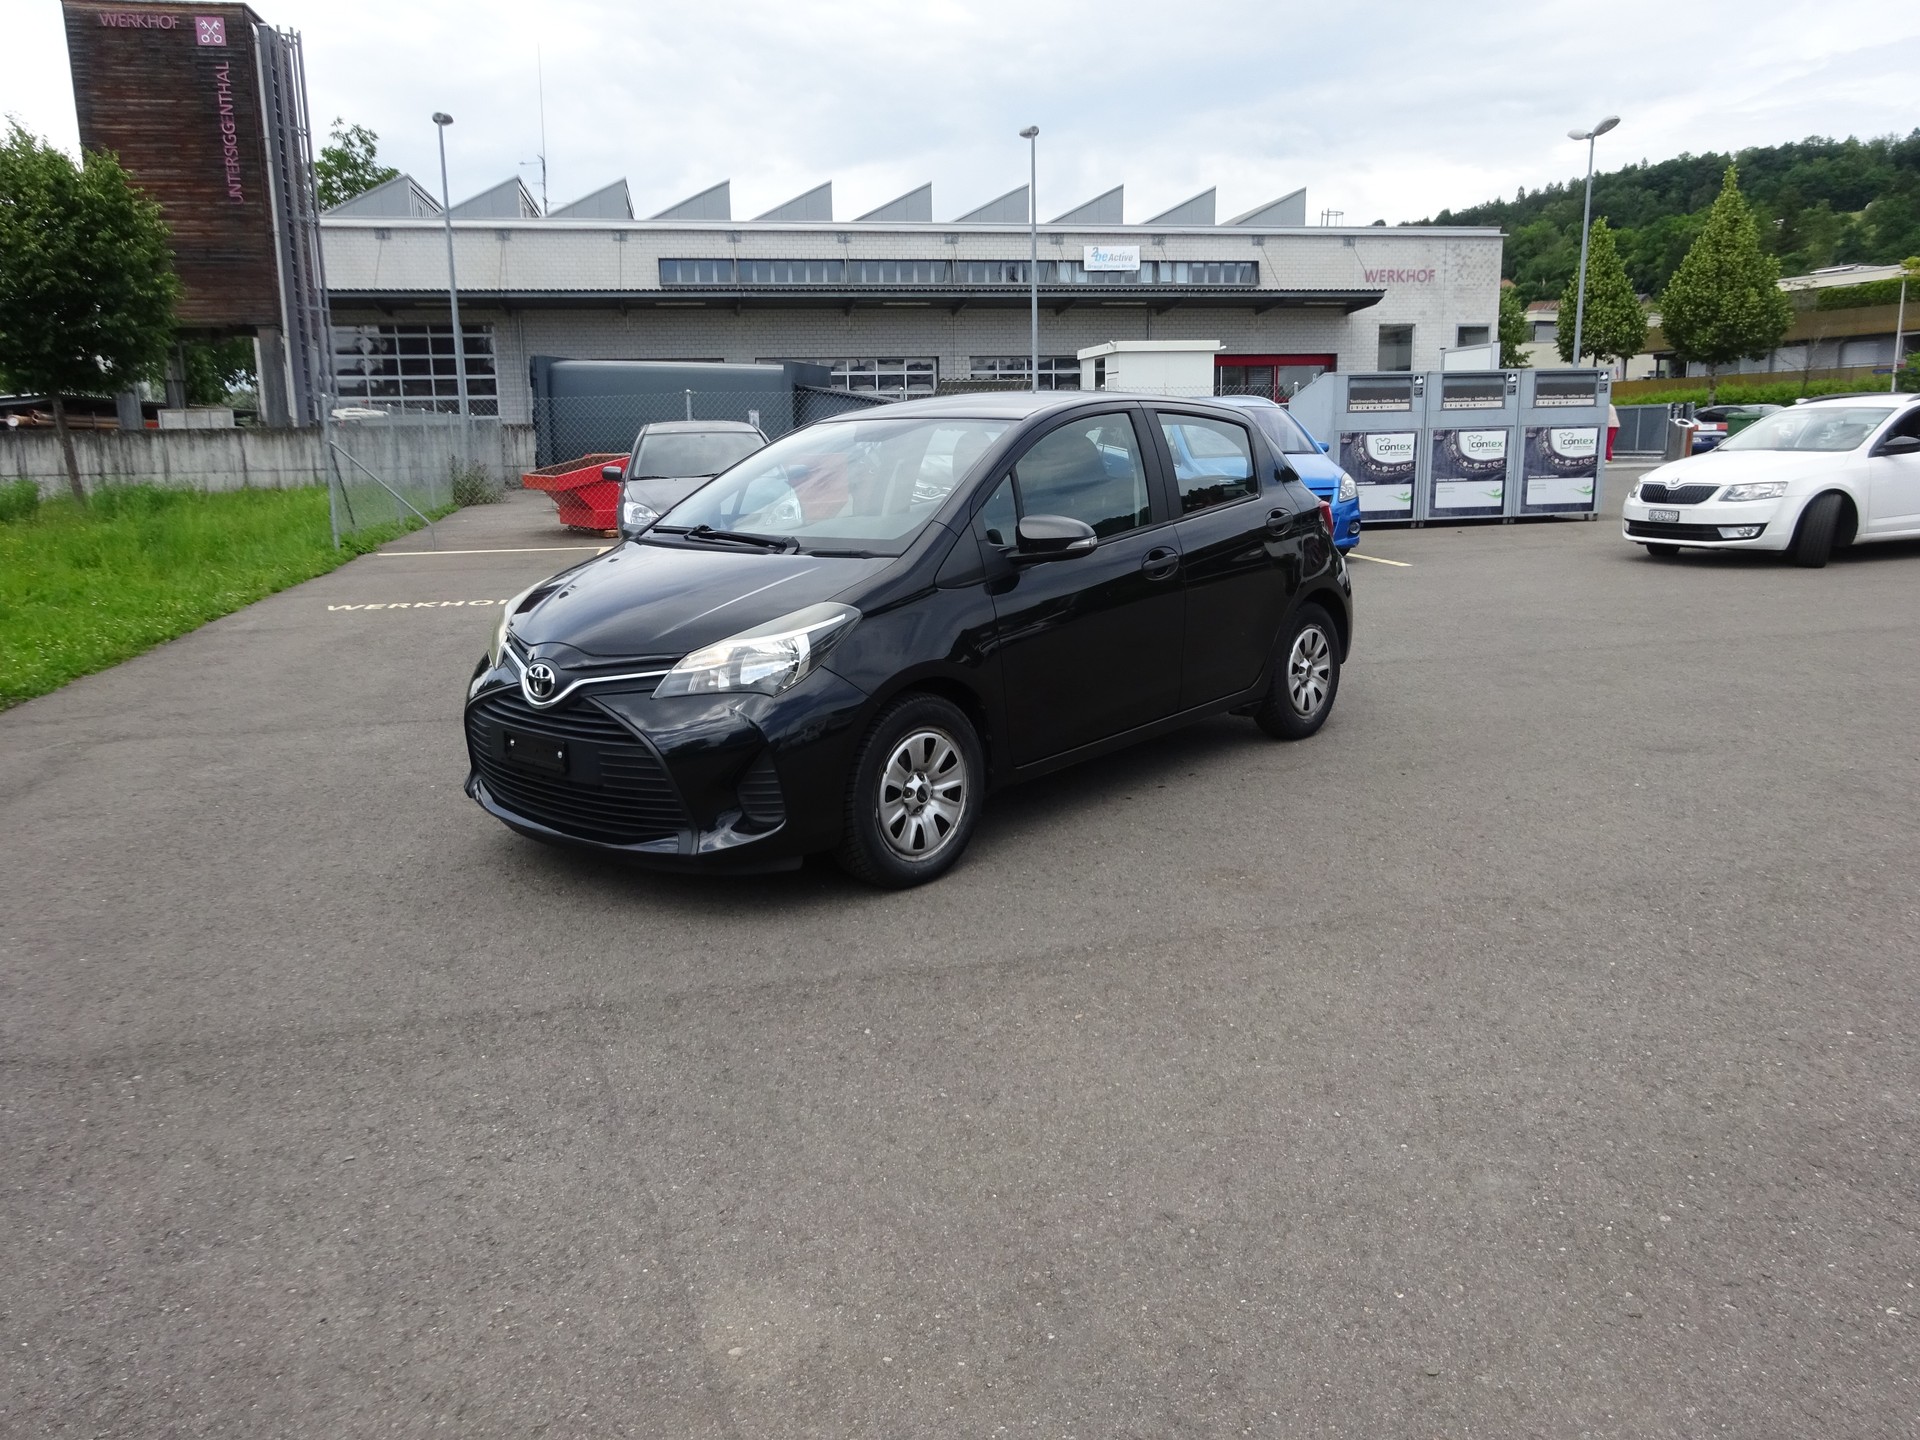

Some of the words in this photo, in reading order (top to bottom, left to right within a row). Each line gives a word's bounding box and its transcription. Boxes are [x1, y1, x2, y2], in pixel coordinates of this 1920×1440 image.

[99, 12, 180, 29] WERKHOF
[216, 61, 244, 205] UNTERSIGGENTHAL
[1108, 252, 1133, 262] Active
[1364, 269, 1436, 283] WERKHOF
[1471, 440, 1503, 448] contex
[1562, 437, 1594, 445] contex
[1379, 443, 1412, 451] contex
